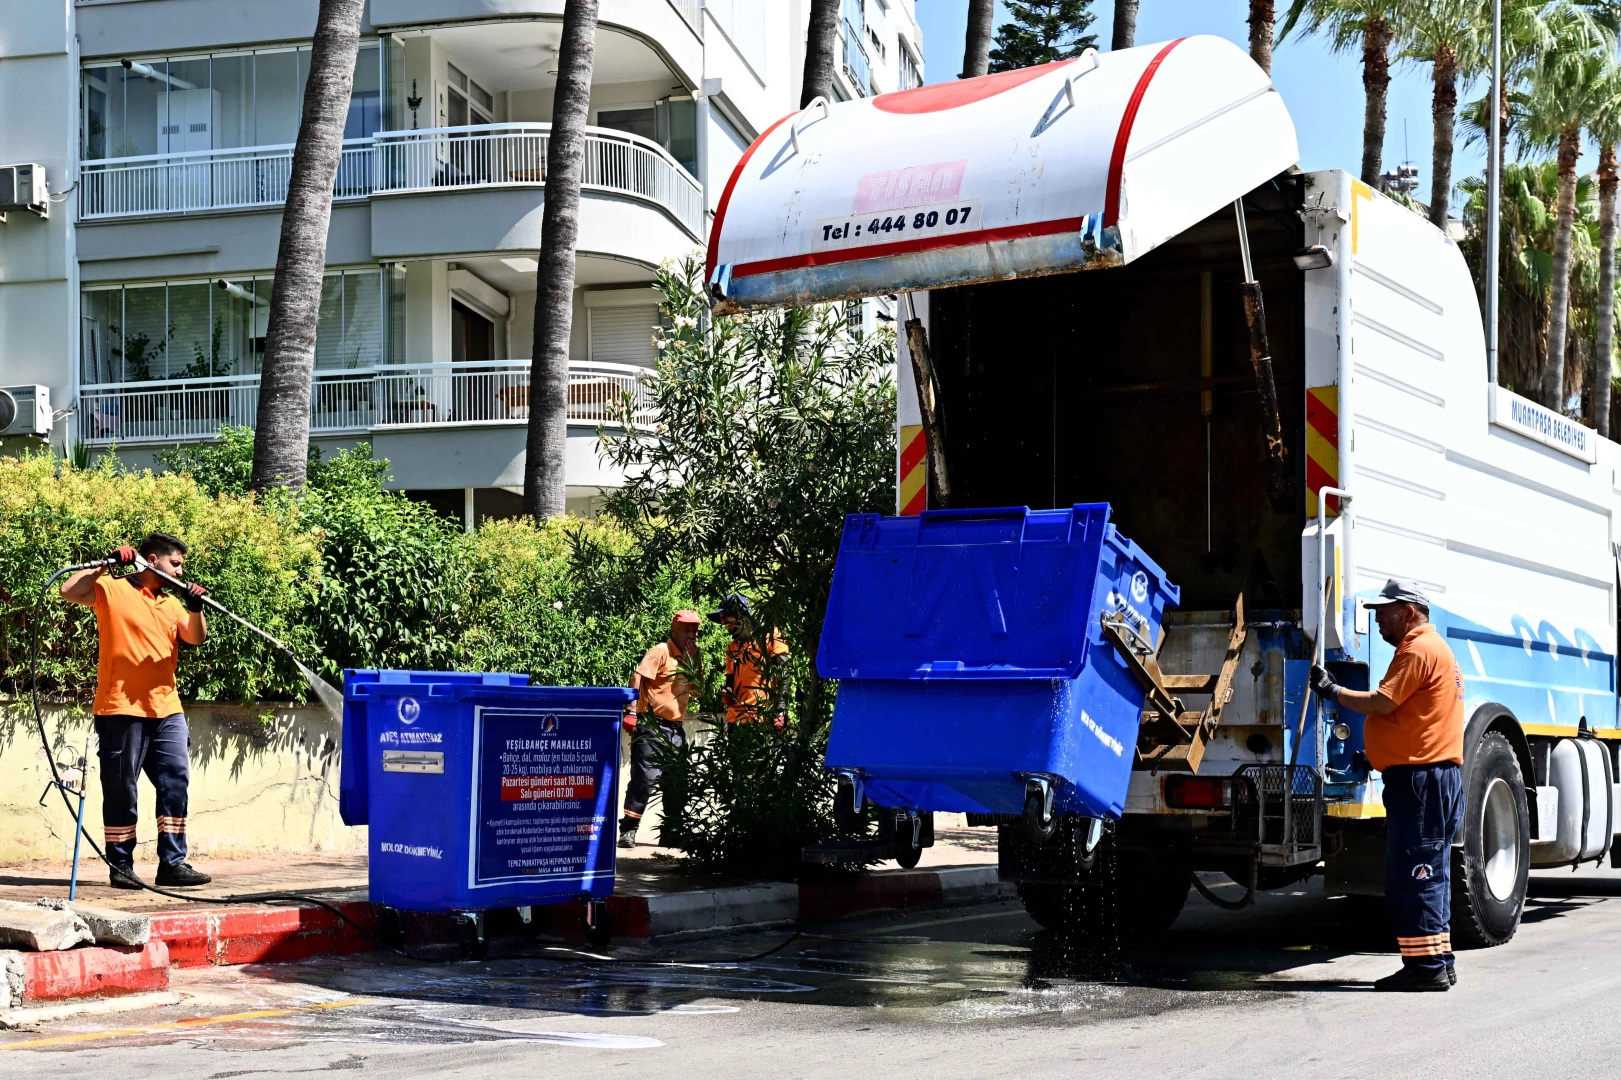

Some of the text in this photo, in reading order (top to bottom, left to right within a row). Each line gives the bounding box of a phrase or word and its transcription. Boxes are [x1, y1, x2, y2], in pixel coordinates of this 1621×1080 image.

[823, 222, 850, 241] Tel
[868, 215, 906, 235] 444
[912, 211, 939, 230] 80
[945, 206, 972, 225] 07
[1511, 399, 1552, 440] MURATPAŞA
[505, 738, 592, 752] YEŞİLBAHÇE MAHALLESİ
[521, 752, 532, 763] dal,
[532, 752, 551, 762] moloz
[551, 752, 560, 764] (en
[561, 752, 575, 762] fazla
[576, 752, 581, 762] 5
[581, 752, 599, 764] çuval,
[502, 764, 594, 777] 20-25 kg), mobilya vb. atıklarınızı
[502, 775, 594, 789] Pazartesi günleri saat 19.00 ile
[520, 787, 574, 800] Salı günleri 07.00
[512, 800, 582, 812] arasında çıkarabilirsiniz.
[381, 842, 403, 853] MOLOZ
[522, 858, 549, 867] MURATPAŞA
